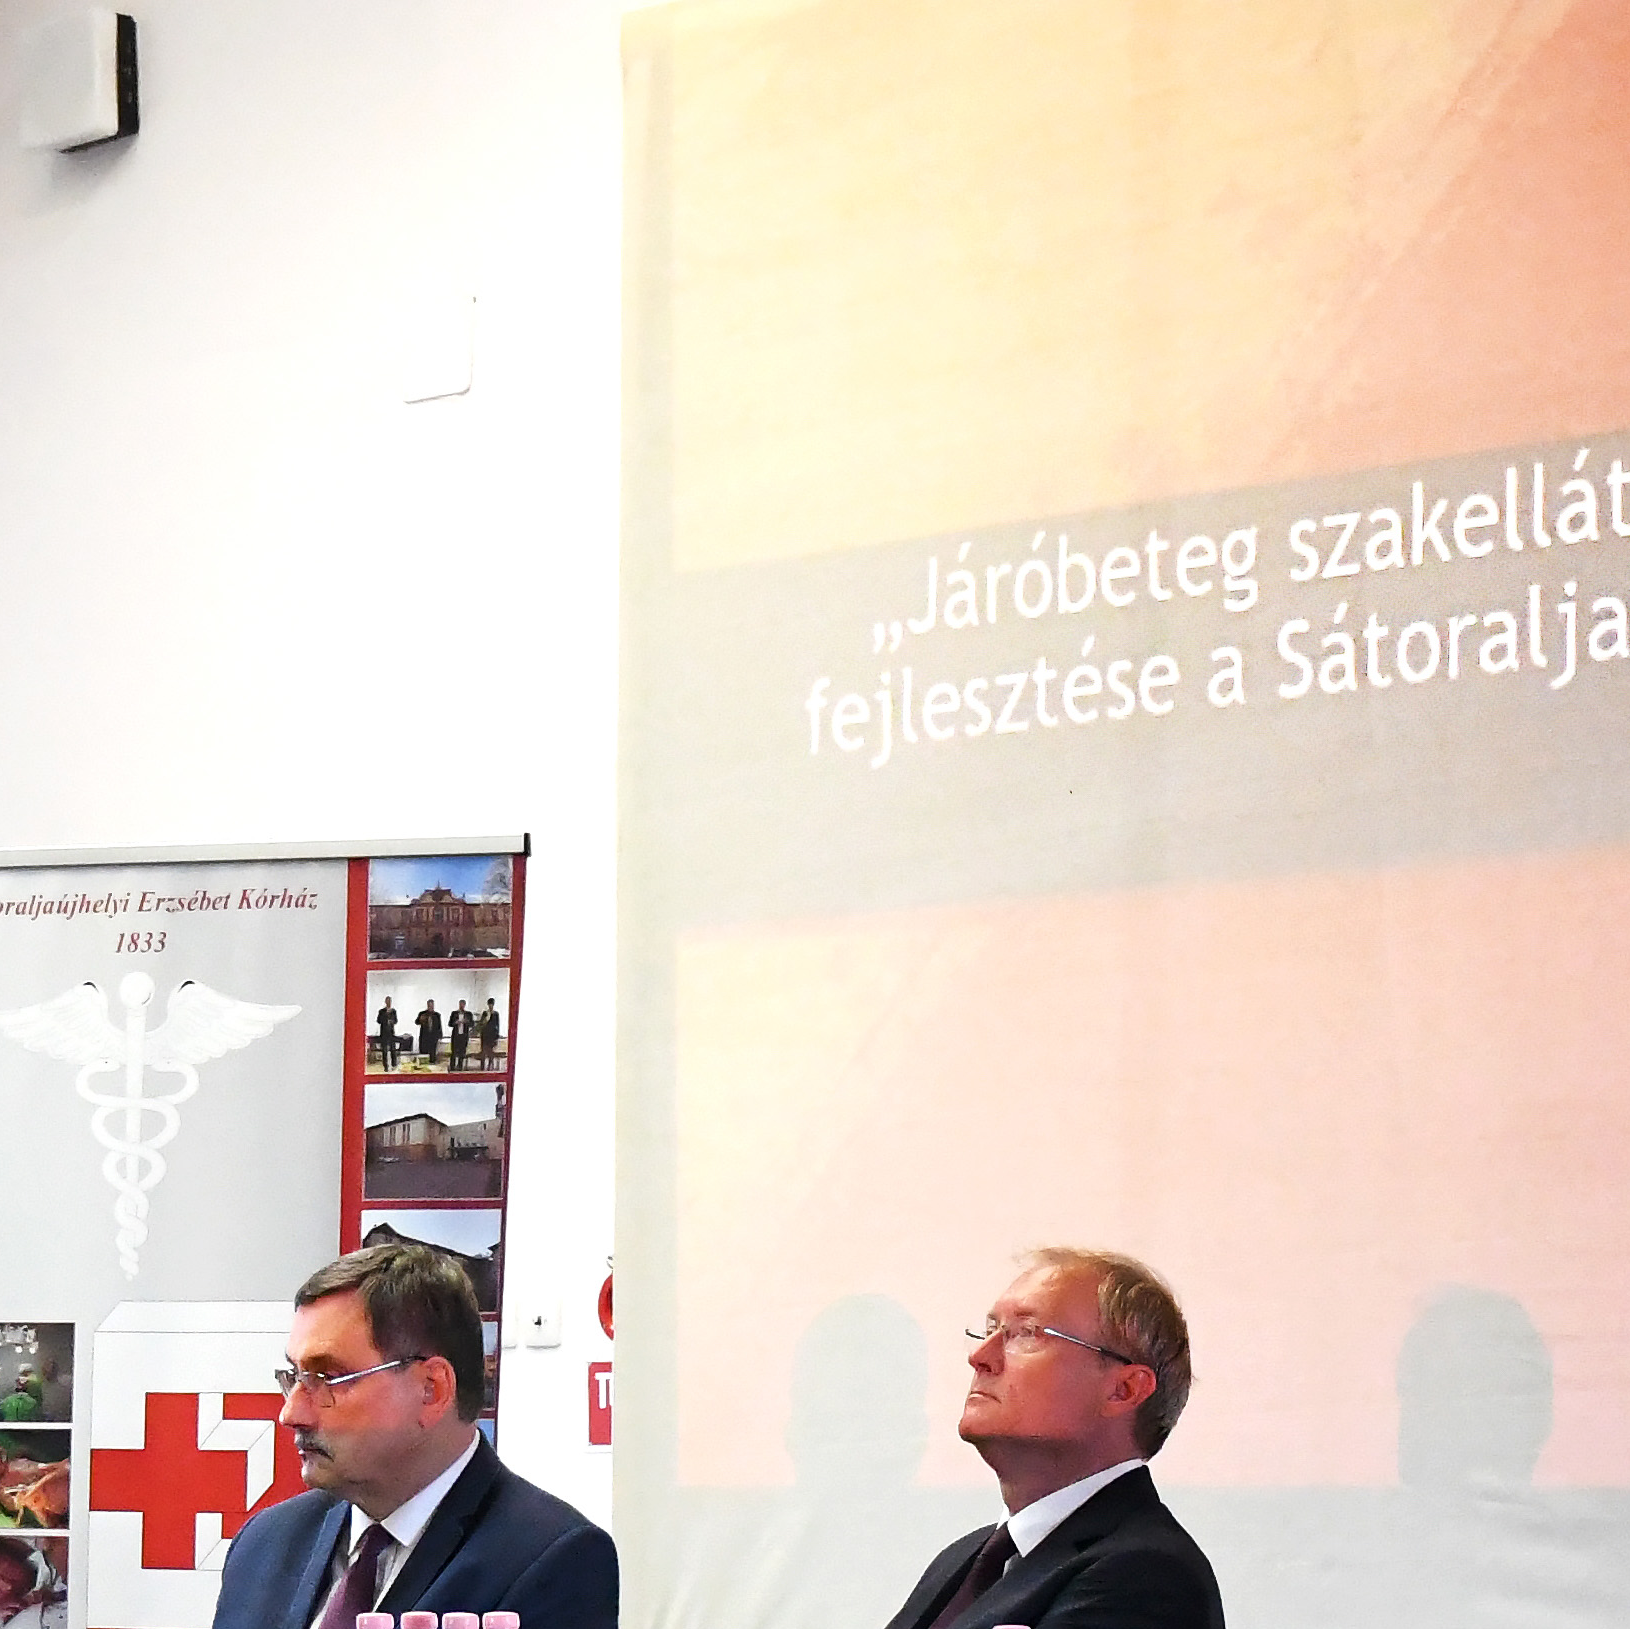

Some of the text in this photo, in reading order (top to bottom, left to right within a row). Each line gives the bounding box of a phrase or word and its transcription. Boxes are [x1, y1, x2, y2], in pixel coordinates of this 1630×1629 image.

[805, 636, 1180, 769] fejlesztése
[1207, 643, 1245, 708] a
[138, 889, 231, 913] Erzsébet
[237, 887, 319, 911] Kórház
[115, 931, 167, 954] 1833
